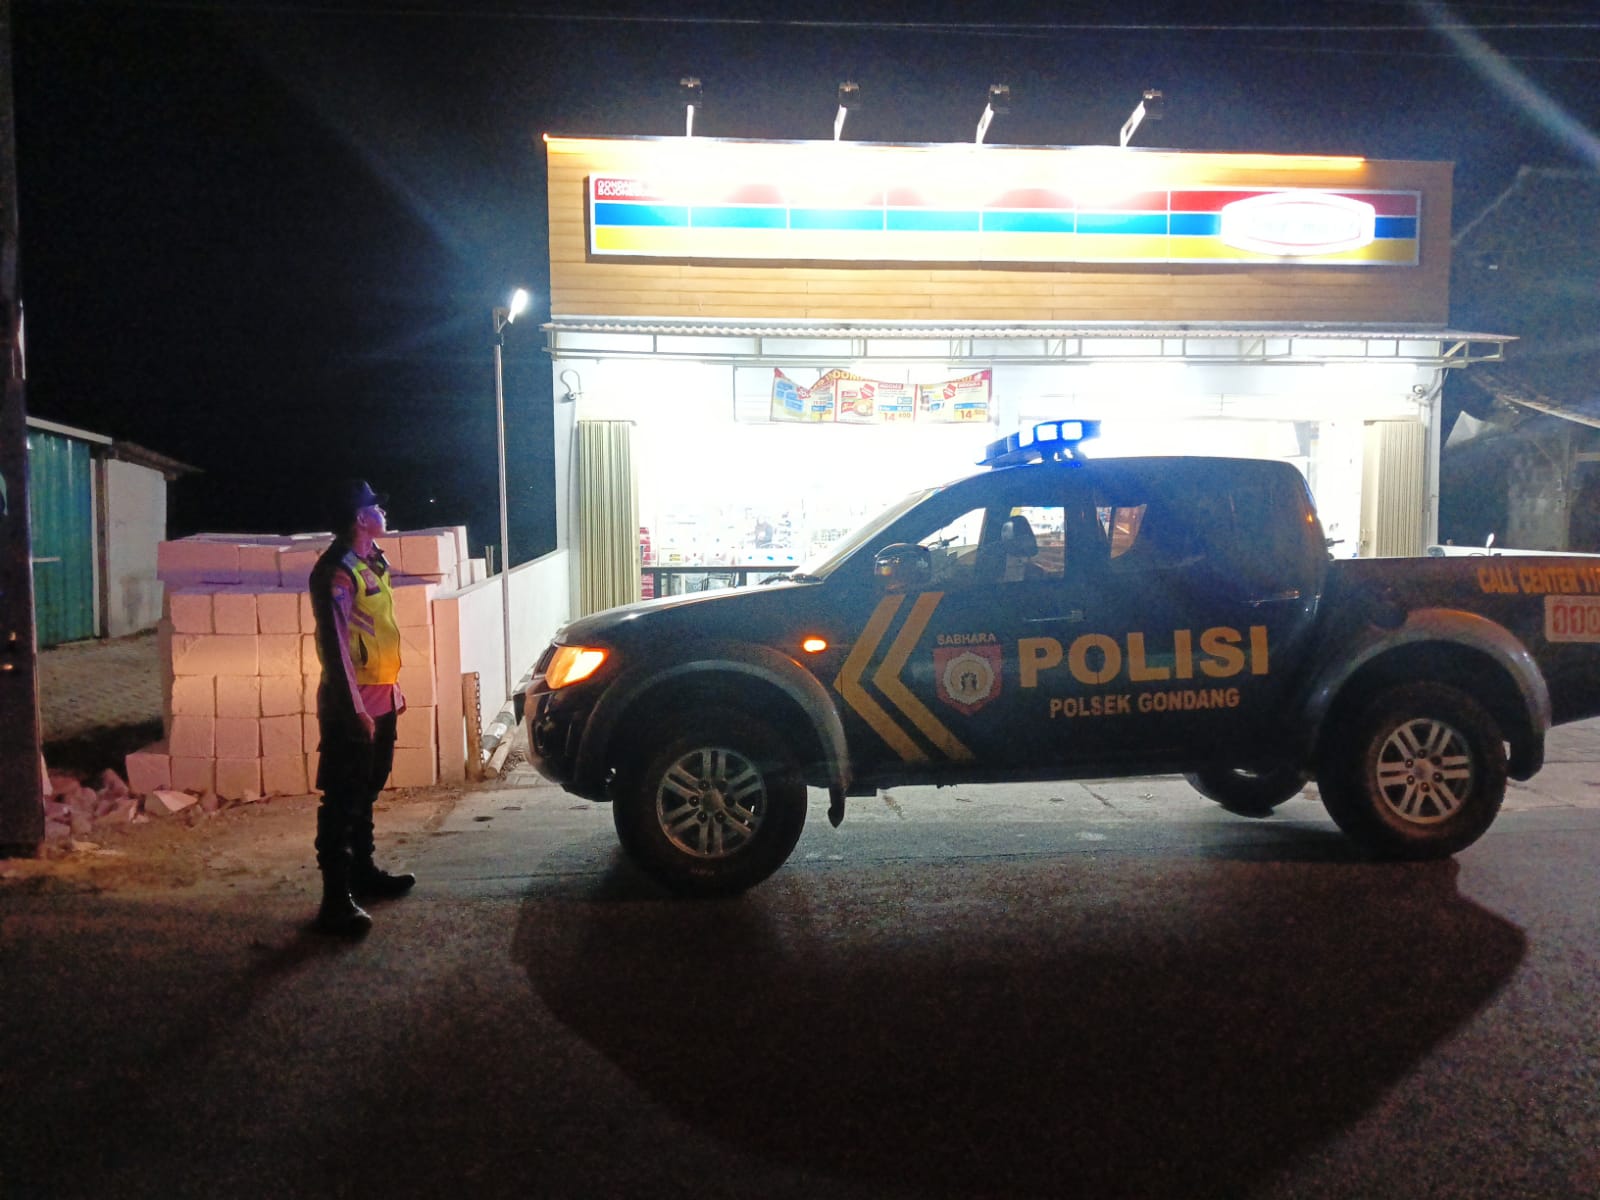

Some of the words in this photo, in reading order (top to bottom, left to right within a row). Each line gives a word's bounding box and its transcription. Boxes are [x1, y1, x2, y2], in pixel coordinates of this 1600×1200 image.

[960, 409, 972, 420] 14
[1476, 567, 1519, 593] CALL
[1519, 566, 1581, 593] CENTER
[936, 633, 997, 645] SABHARA
[1018, 625, 1270, 688] POLISI
[1049, 694, 1132, 719] POLSEK
[1137, 688, 1241, 713] GONDANG
